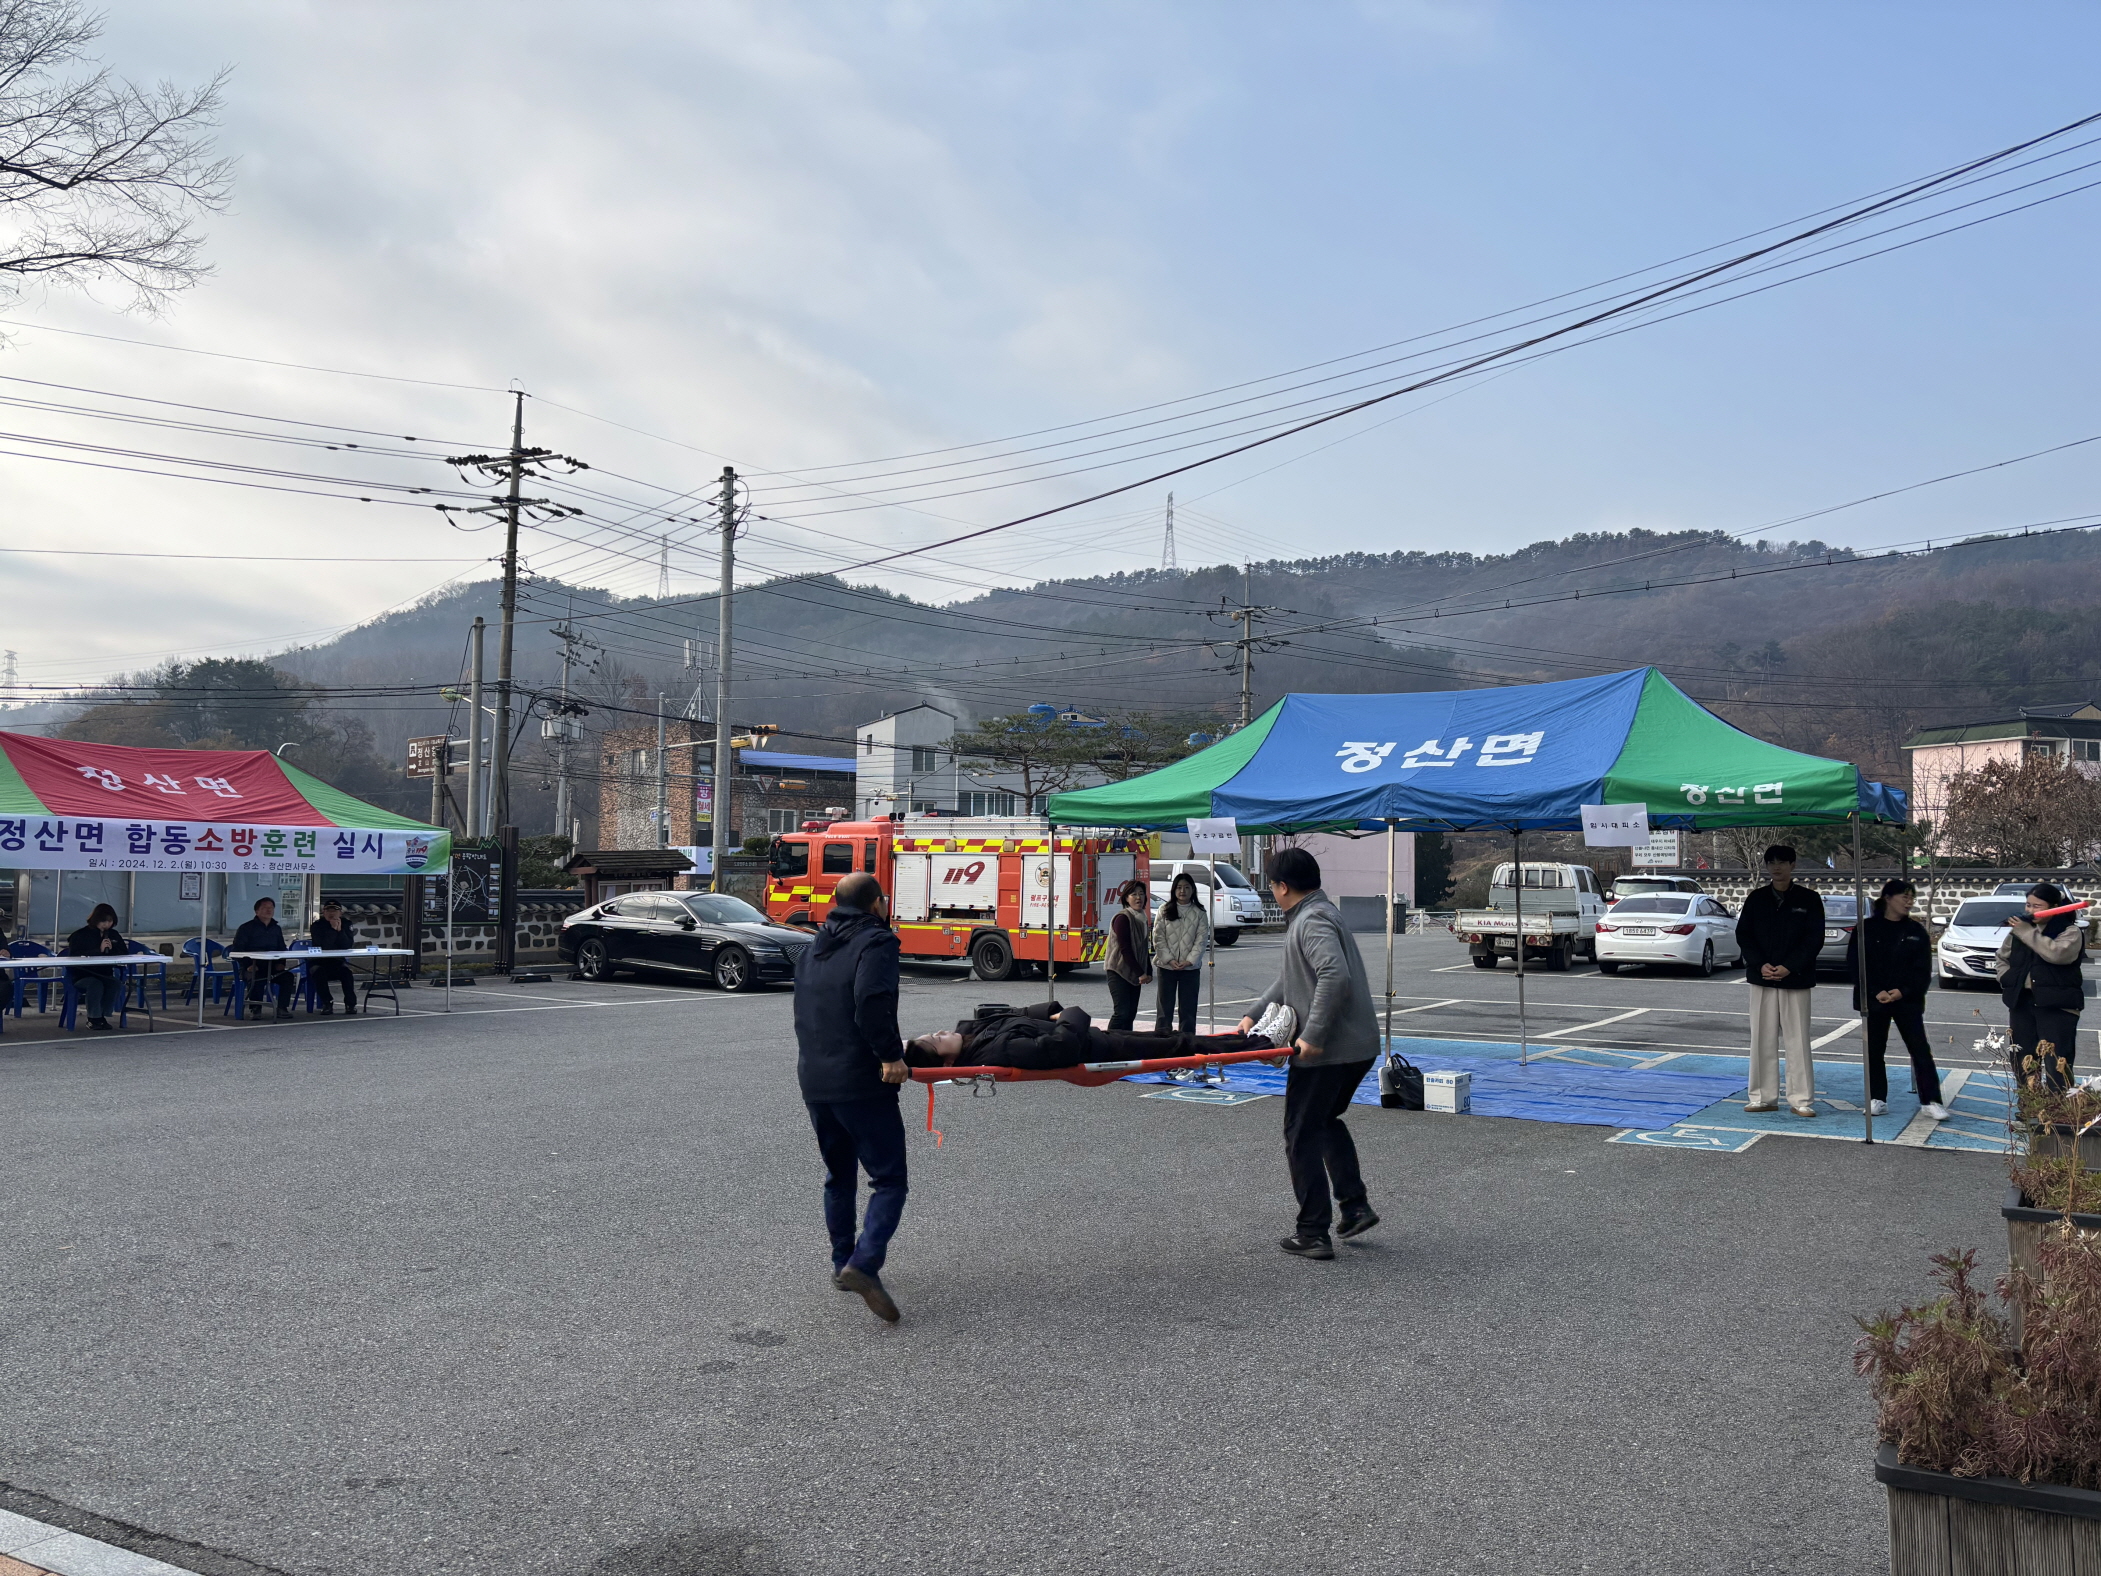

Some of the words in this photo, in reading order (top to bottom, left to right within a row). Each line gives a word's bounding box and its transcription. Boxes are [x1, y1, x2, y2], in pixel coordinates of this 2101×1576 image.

[1335, 731, 1545, 773] 정산면
[77, 766, 244, 798] 정산면
[1680, 782, 1783, 805] 정산면
[0, 819, 104, 852] 정산면
[126, 824, 316, 857] 합동소방훈련
[333, 832, 383, 860] 실시
[89, 859, 107, 868] 일시
[118, 860, 149, 868] 2024.
[201, 861, 227, 869] 10:30
[243, 862, 259, 870] 장소
[269, 862, 316, 871] 정산면사무소
[942, 861, 986, 885] 119
[1031, 894, 1060, 902] 펌프구대
